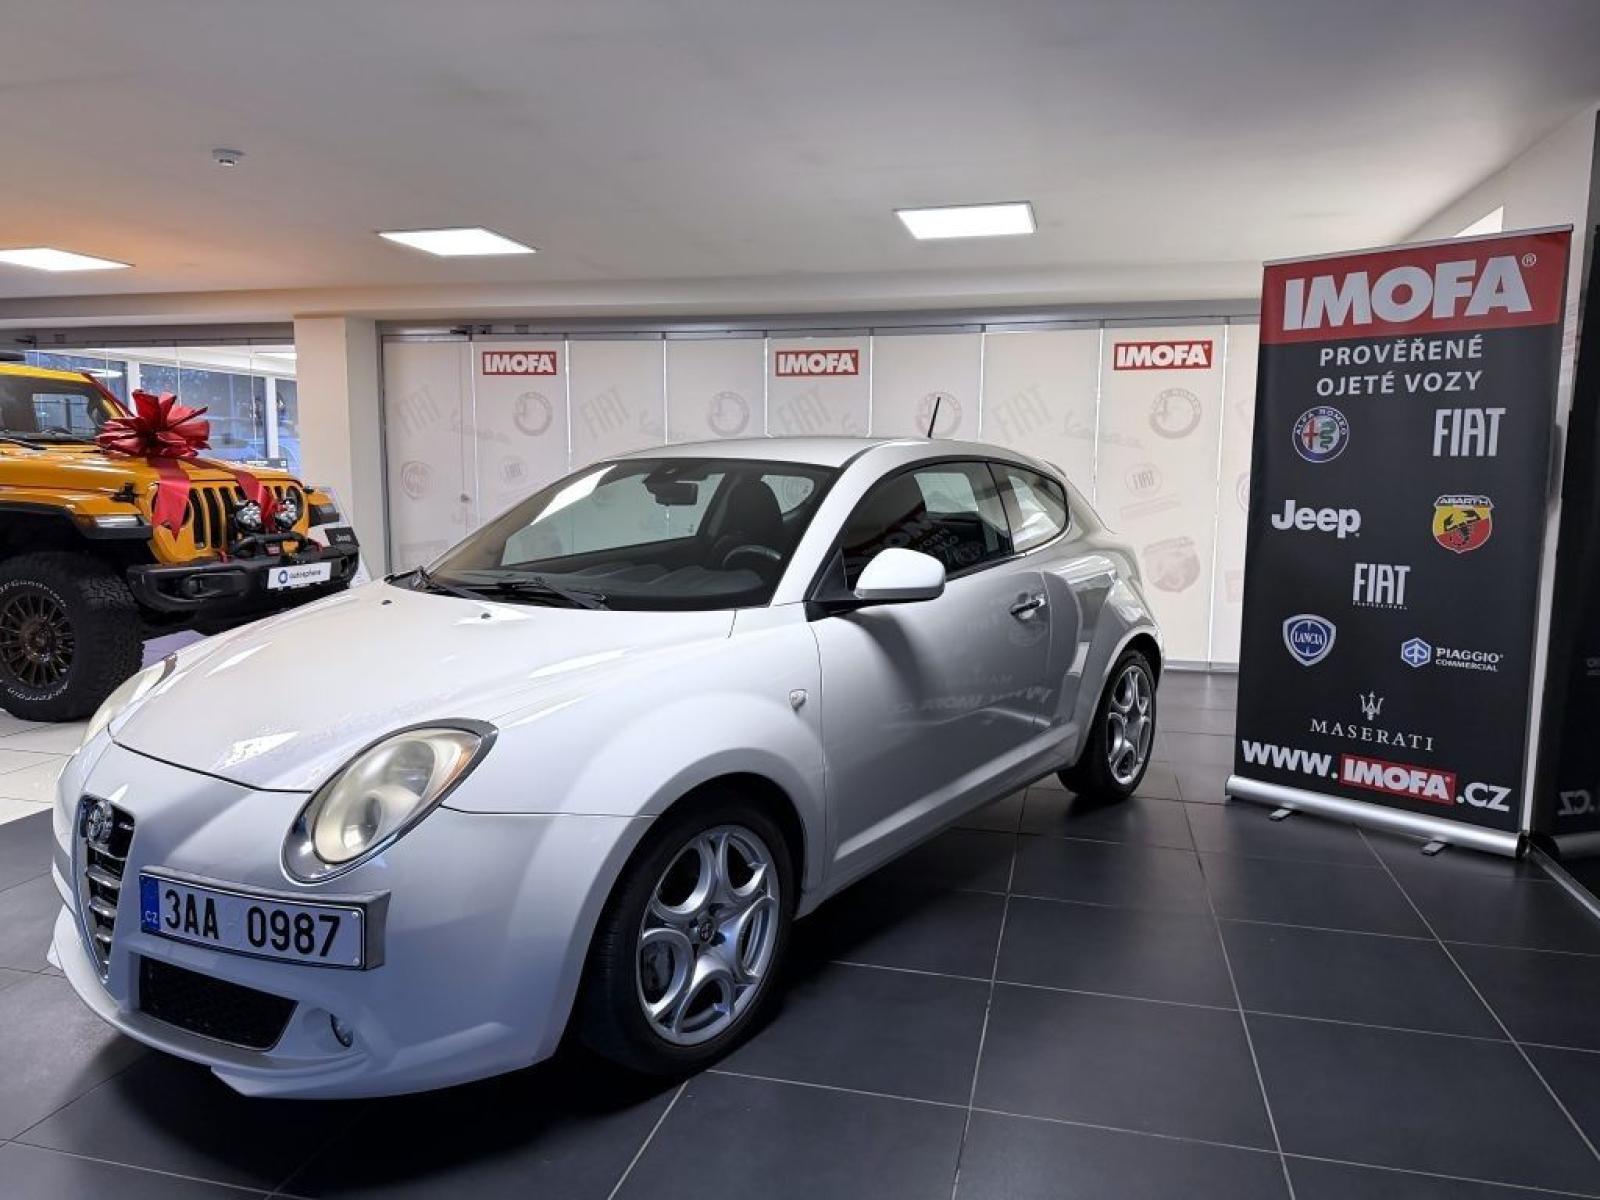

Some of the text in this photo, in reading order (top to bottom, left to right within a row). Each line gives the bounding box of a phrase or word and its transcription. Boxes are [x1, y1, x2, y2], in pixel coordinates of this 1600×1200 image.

[485, 353, 554, 373] IMOFA
[778, 353, 855, 373] IMOFA
[1117, 344, 1208, 367] IMOFA
[1320, 335, 1483, 366] PROVĚŘENÉ
[1316, 370, 1483, 396] OJETÉ VOZY
[1433, 407, 1506, 457] FIAT
[1272, 500, 1361, 539] Jeep
[1353, 563, 1411, 605] FIAT
[1436, 647, 1499, 663] PIAGGIO
[1436, 659, 1498, 672] COMMERCIAL
[1309, 719, 1435, 751] MASERATI
[165, 888, 341, 958] 3AA 0987
